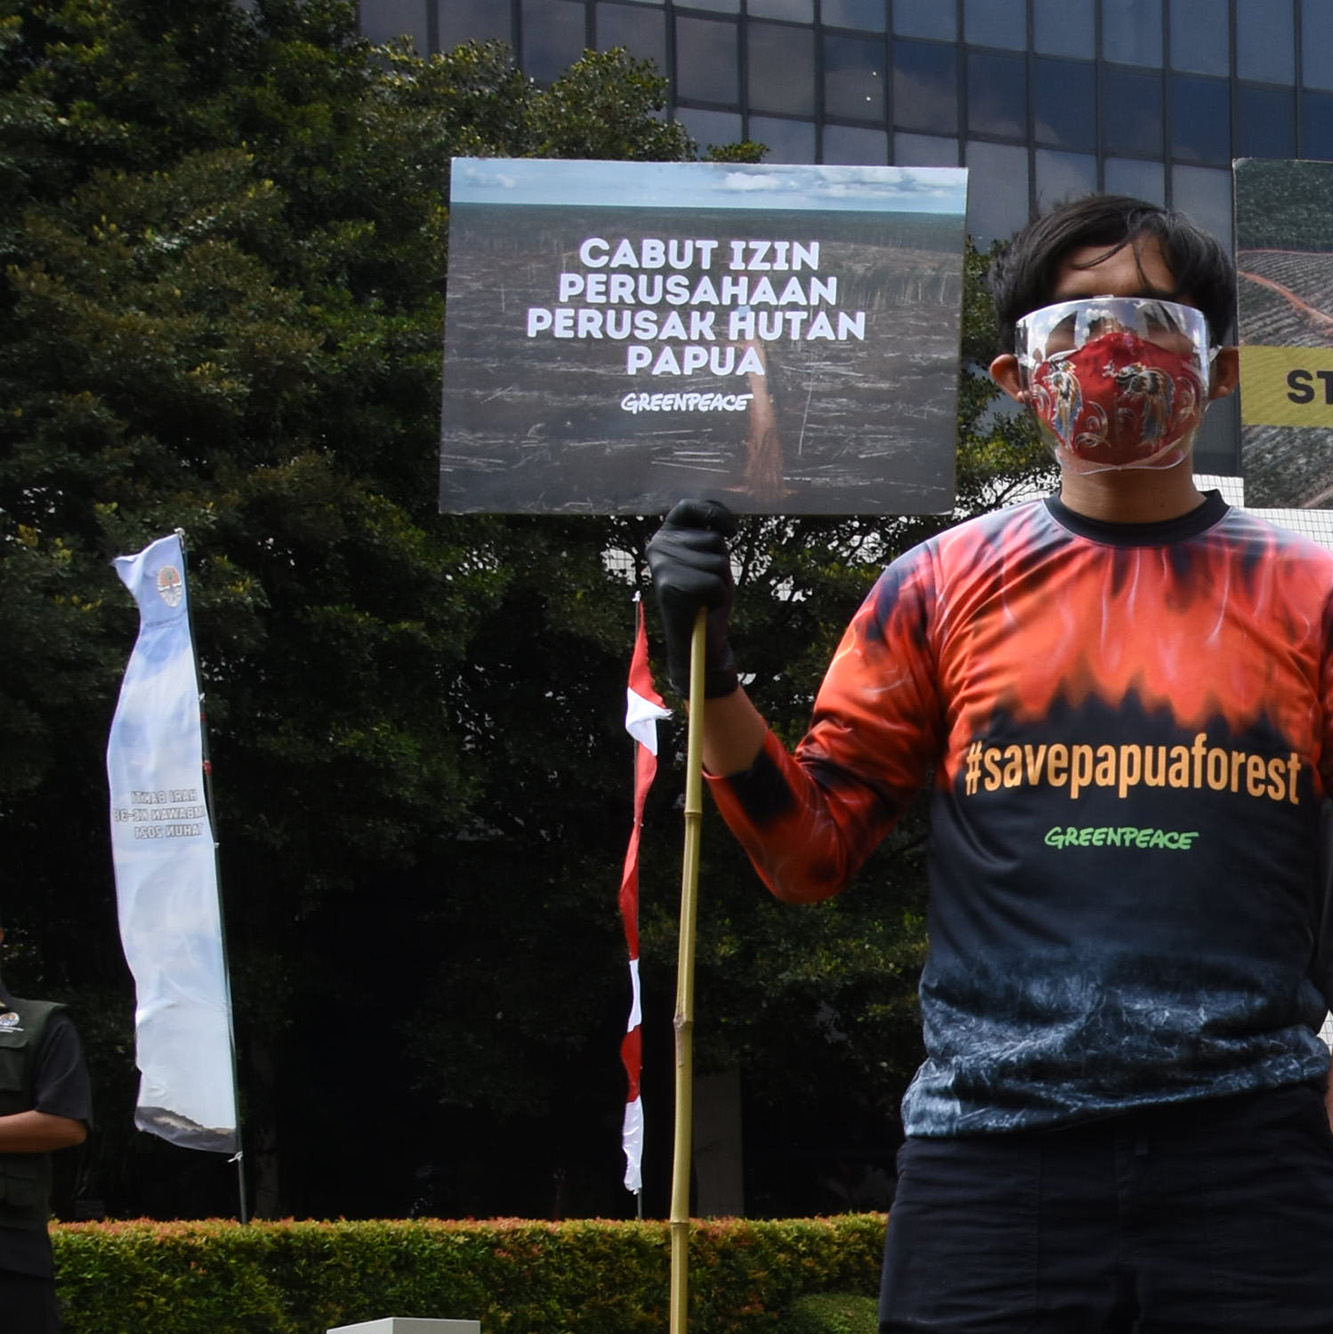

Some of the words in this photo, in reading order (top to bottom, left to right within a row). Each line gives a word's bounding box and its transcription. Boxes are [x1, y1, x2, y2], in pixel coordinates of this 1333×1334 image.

[580, 237, 718, 270] CABUT
[728, 240, 820, 271] IZIN
[559, 273, 838, 306] PERUSAHAAN
[527, 308, 716, 341] PERUSAK
[729, 310, 866, 341] HUTAN
[627, 345, 765, 376] PAPUA
[621, 392, 754, 413] GREENPEACE
[965, 733, 1301, 805] #savepapuaforest
[1044, 826, 1199, 850] GREENPEACE
